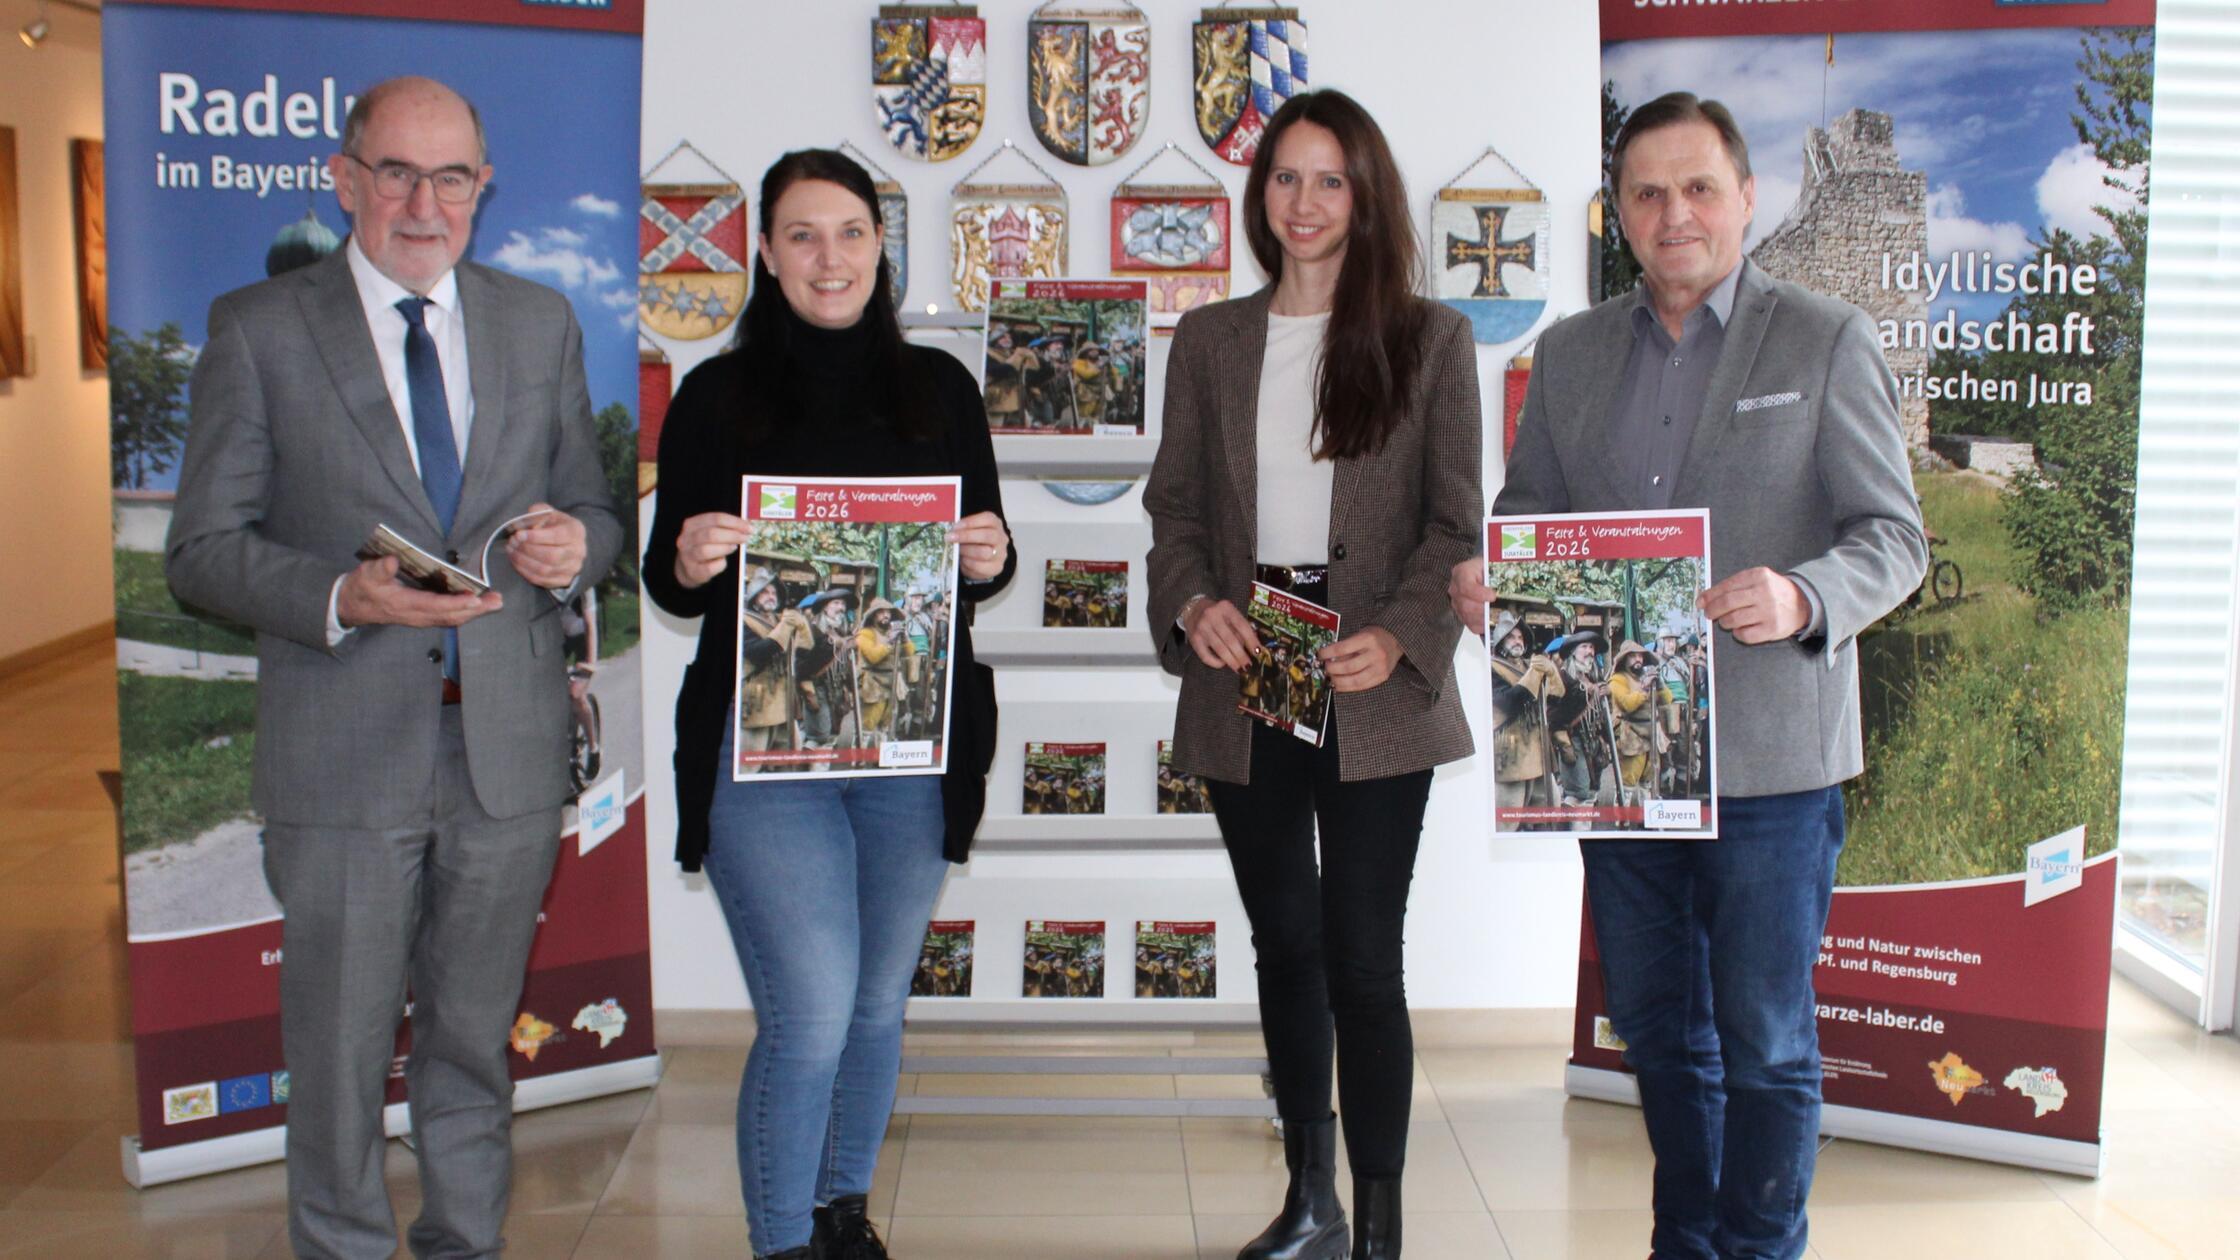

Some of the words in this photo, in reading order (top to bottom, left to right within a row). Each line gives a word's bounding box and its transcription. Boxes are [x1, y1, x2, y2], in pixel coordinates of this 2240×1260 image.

[156, 152, 200, 189] im
[1881, 250, 2097, 303] Idyllische
[1893, 368, 2018, 402] rischen
[2027, 373, 2093, 410] Jura
[838, 489, 847, 501] &
[804, 503, 849, 518] 2026
[1546, 526, 1574, 539] Feste
[1578, 525, 1587, 537] &
[1592, 522, 1684, 541] Veranstaltungen
[1545, 539, 1590, 556] 2026
[891, 750, 928, 760] Bayern
[1657, 810, 1696, 821] Bayern
[2030, 856, 2081, 874] Bayern
[1837, 936, 1865, 950] und
[1869, 938, 1911, 956] Natur
[1914, 945, 1982, 965] zwischen
[1840, 958, 1868, 972] und
[1872, 959, 1958, 986] Regensburg
